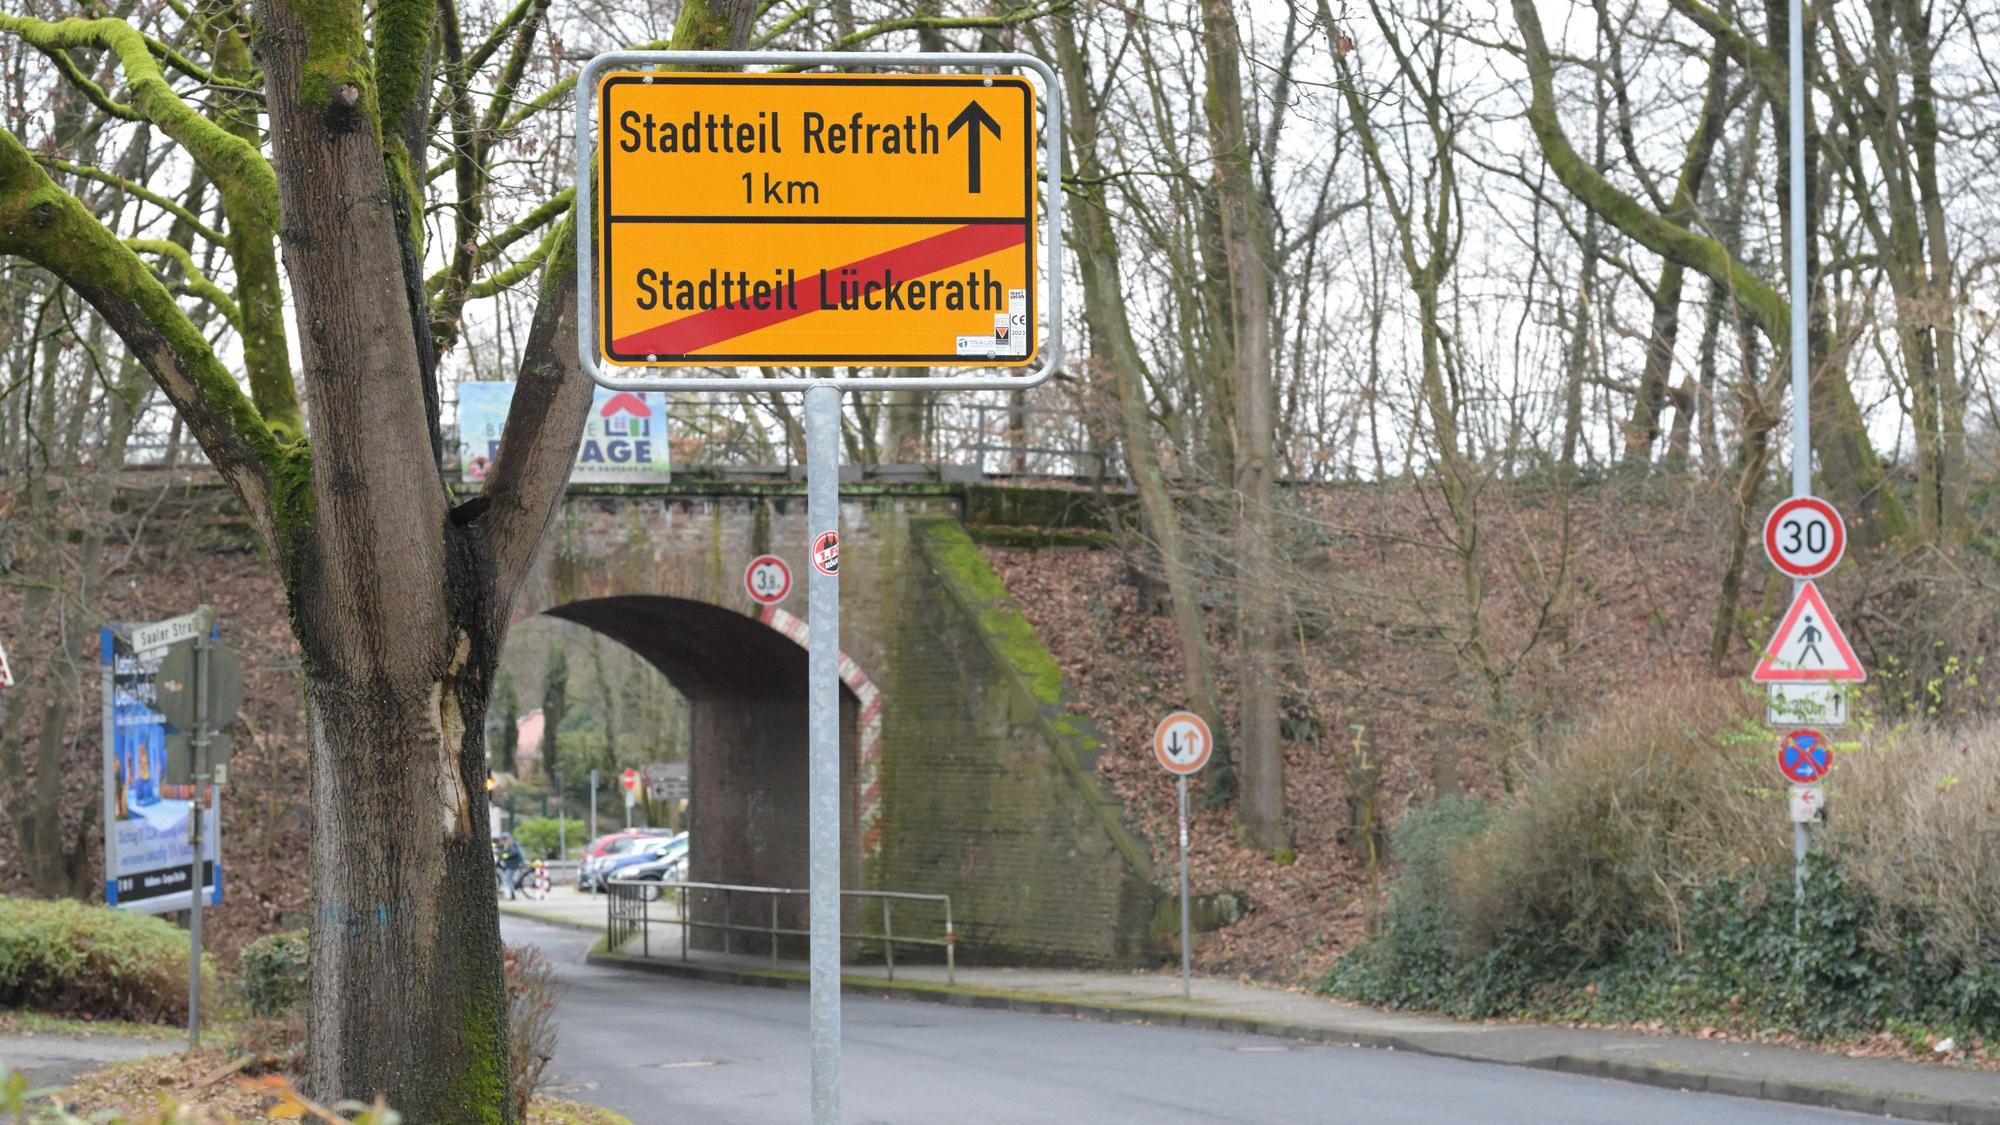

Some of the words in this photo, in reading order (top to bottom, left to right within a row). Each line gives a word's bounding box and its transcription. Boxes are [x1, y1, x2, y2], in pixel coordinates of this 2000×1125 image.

[619, 110, 782, 154] Stadtteil
[802, 111, 940, 155] Refrath
[741, 171, 753, 204] 1
[763, 172, 819, 204] km
[636, 267, 798, 310] Stadtteil
[819, 268, 1003, 311] Lückerath
[1011, 314, 1026, 326] CE
[1782, 519, 1827, 555] 30
[141, 629, 169, 646] Saaler
